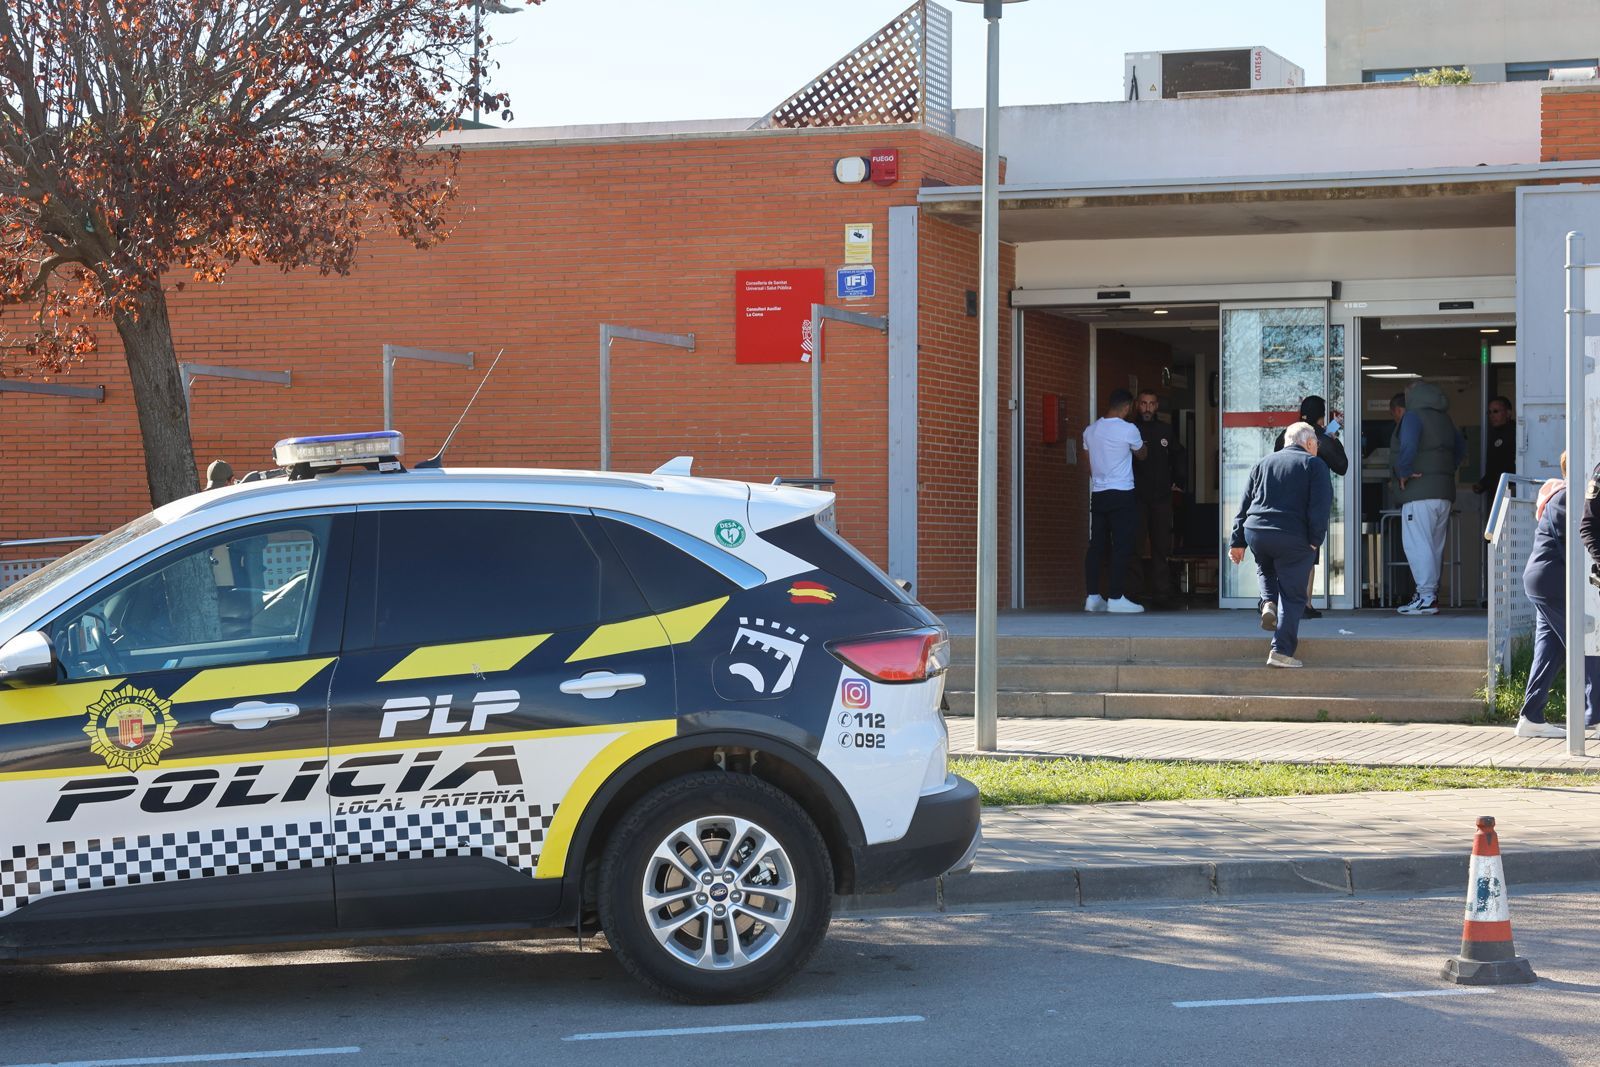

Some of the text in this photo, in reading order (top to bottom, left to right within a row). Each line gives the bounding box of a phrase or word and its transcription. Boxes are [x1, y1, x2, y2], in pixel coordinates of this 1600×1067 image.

[846, 275, 866, 287] IFI
[719, 521, 737, 530] DESA
[102, 698, 158, 718] POLICIA LOCAL
[379, 690, 520, 738] PLP
[854, 713, 885, 729] 112
[854, 733, 885, 749] 092
[107, 744, 155, 756] PATERNA
[46, 745, 523, 823] POLICIA
[335, 789, 526, 816] LOCAL PATERNA
